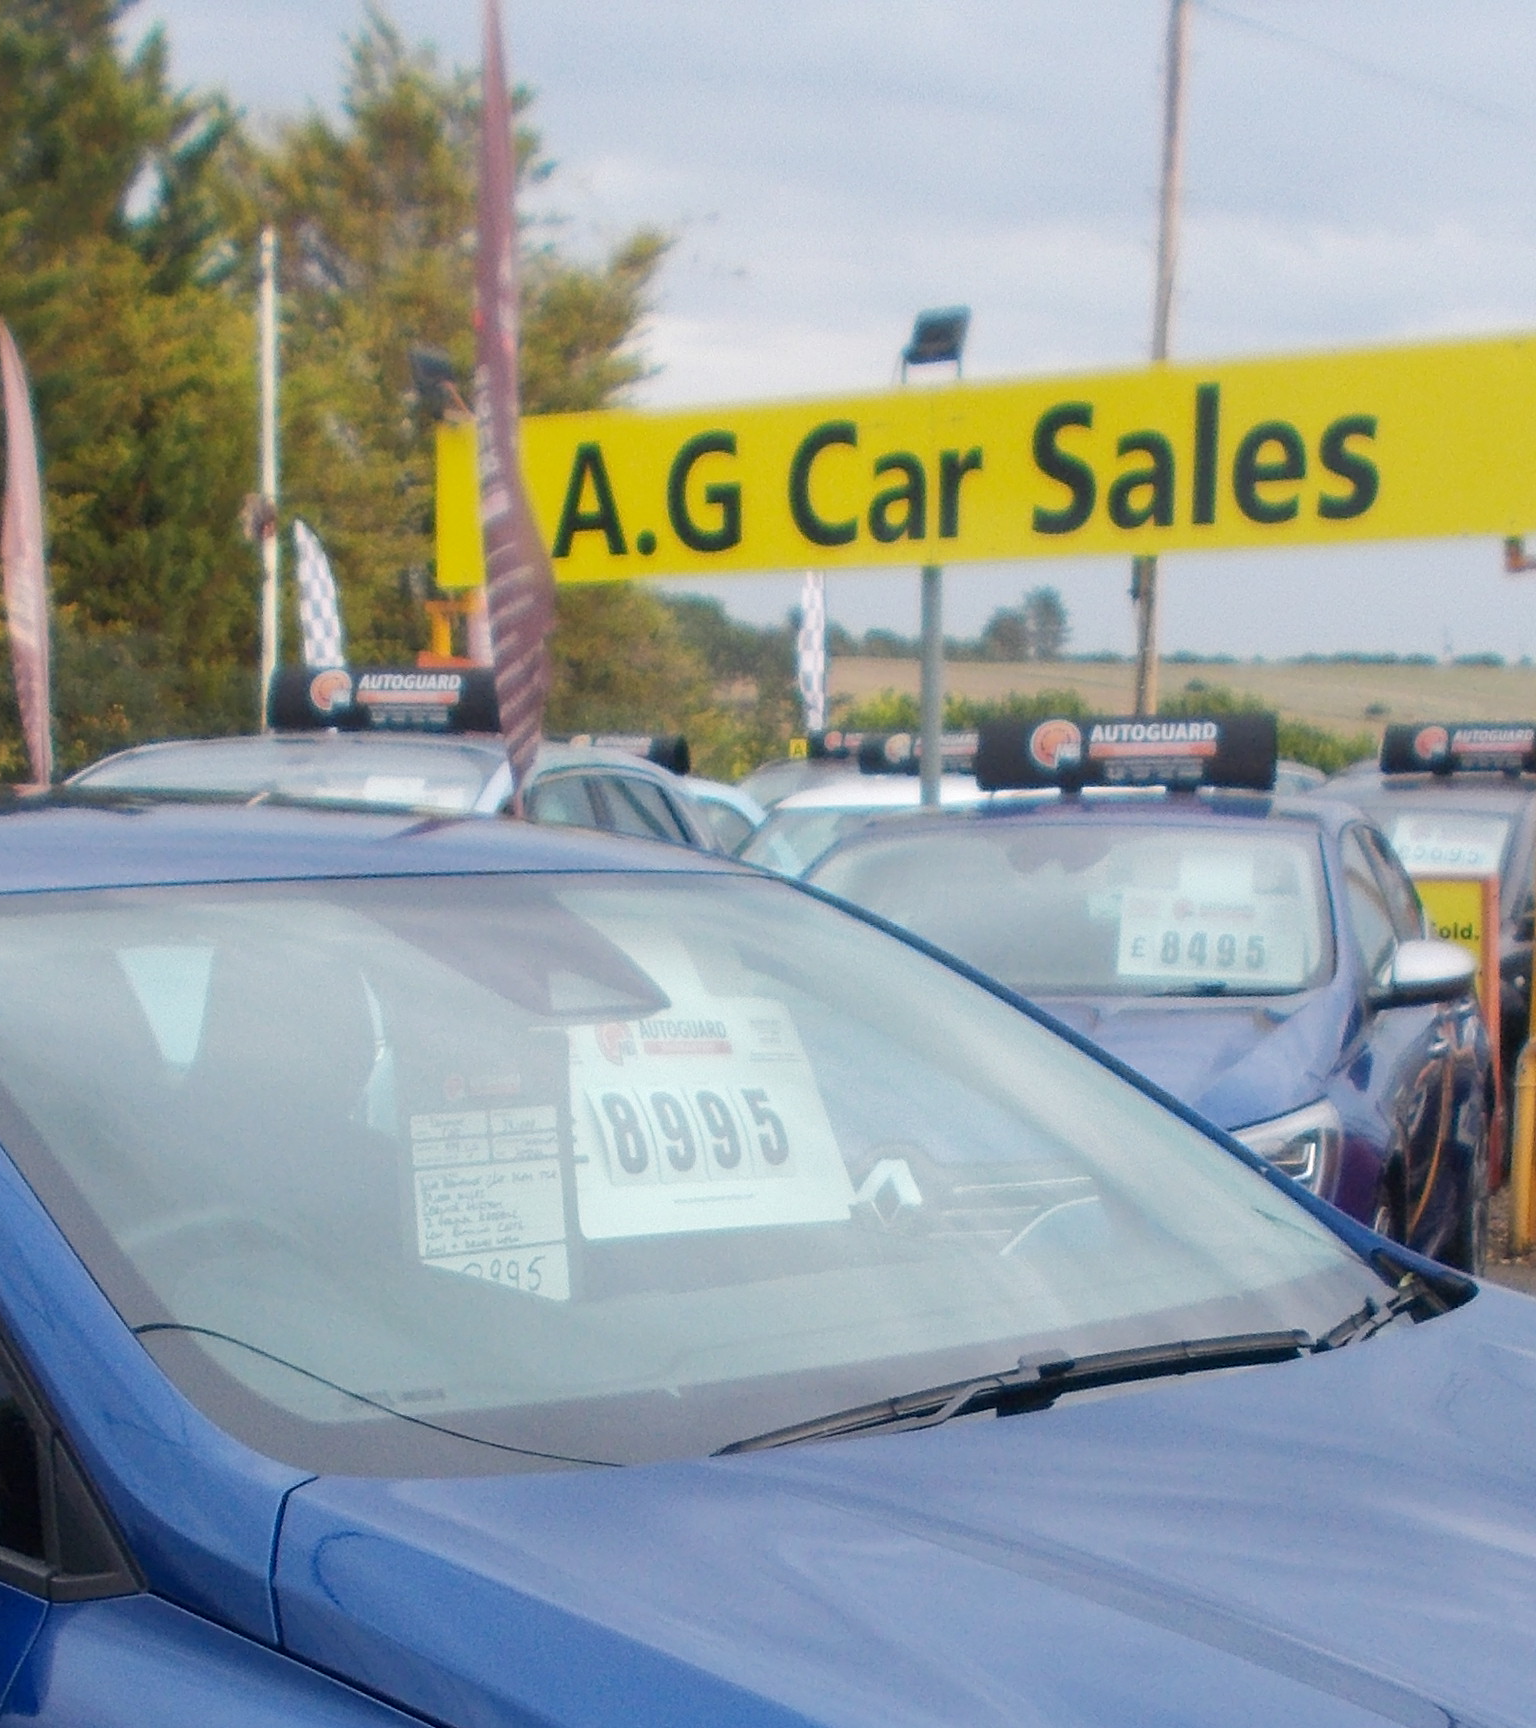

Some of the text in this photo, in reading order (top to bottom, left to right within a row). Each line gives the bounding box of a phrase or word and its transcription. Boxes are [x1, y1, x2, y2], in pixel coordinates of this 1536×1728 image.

[550, 381, 1381, 561] A.G Car Sales
[359, 673, 461, 689] AUTOGUARD
[1090, 722, 1216, 743] AUTOGUARD
[1431, 920, 1480, 941] old.
[637, 1018, 728, 1041] AUTOGUARD
[600, 1087, 790, 1175] 8995
